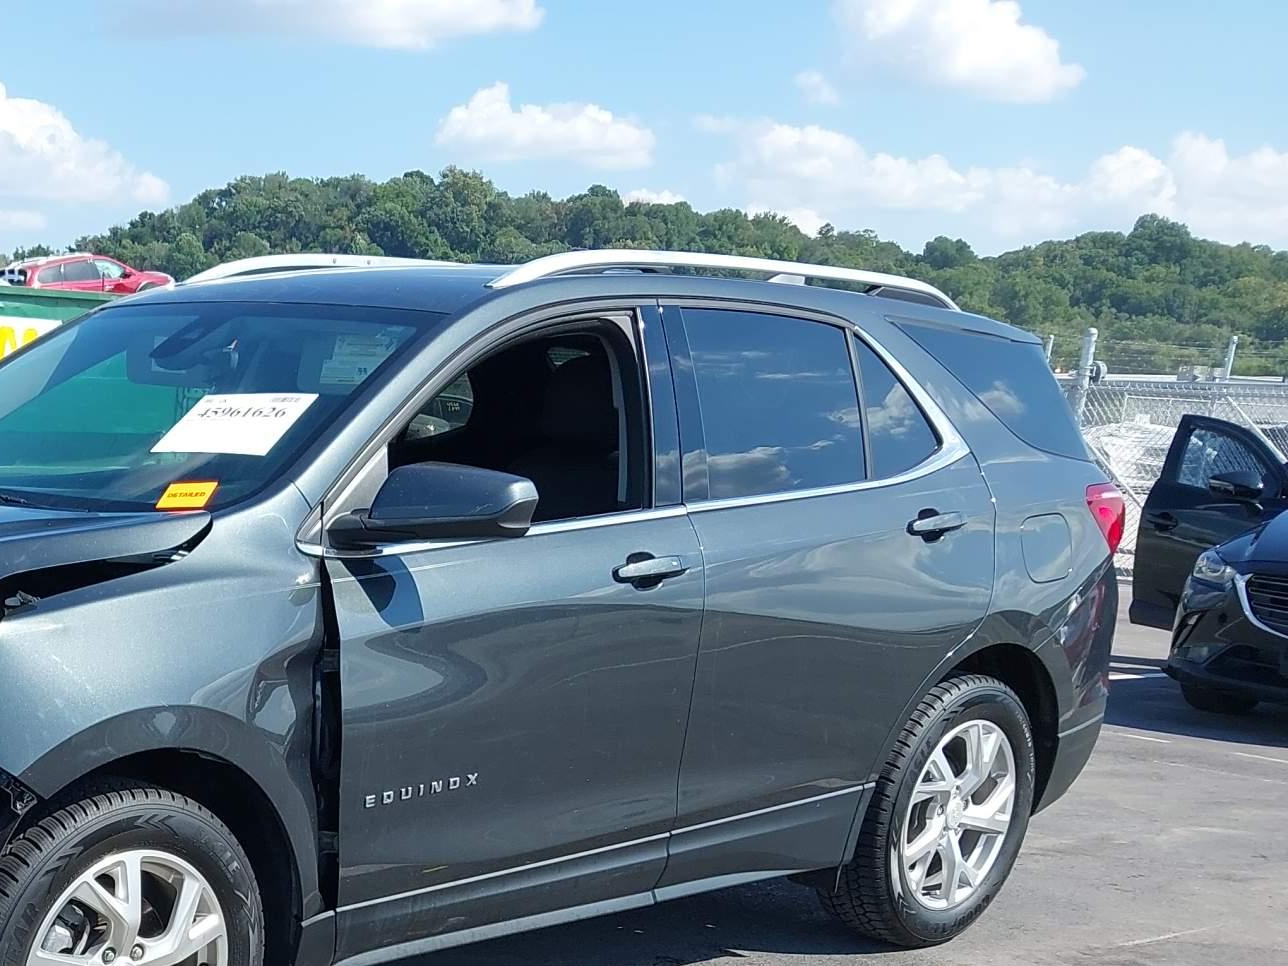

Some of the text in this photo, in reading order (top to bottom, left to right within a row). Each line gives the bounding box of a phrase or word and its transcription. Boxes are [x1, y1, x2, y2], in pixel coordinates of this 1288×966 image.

[197, 406, 288, 418] 45961626
[166, 491, 207, 499] DETAILED
[364, 772, 479, 808] EQUINOX
